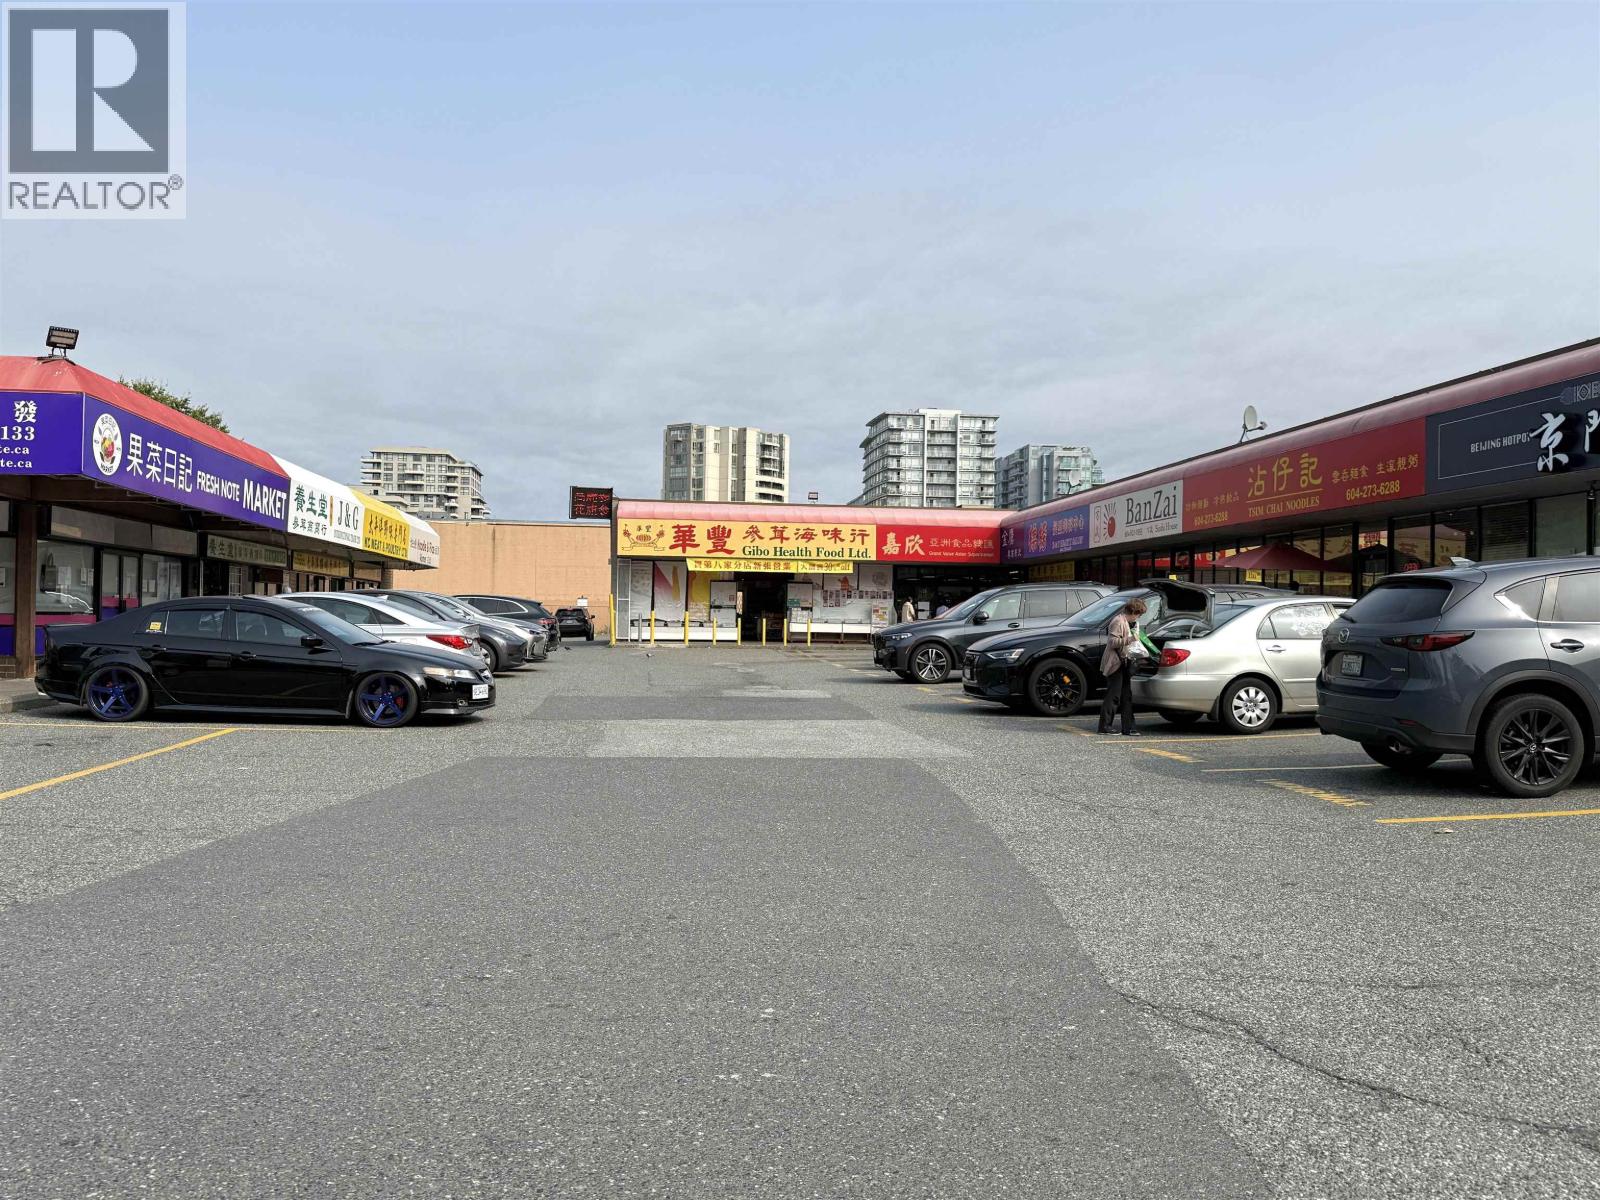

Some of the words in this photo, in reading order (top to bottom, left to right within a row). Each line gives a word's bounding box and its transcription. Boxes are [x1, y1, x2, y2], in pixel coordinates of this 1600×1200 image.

[14, 400, 38, 423] 發
[1470, 438, 1501, 453] BEIJING
[126, 432, 193, 493] 果菜日記
[1248, 453, 1323, 497] 沾仔記
[196, 470, 220, 496] FRESH
[221, 478, 240, 502] NOTE
[242, 478, 287, 520] MARKET
[1346, 480, 1400, 500] 604-273-6288
[1125, 486, 1177, 525] BanZai
[1248, 506, 1264, 517] TSIM
[1266, 502, 1283, 514] CHAI
[1285, 496, 1320, 511] NOODLES
[353, 506, 359, 530] G
[669, 524, 735, 554] 華豐
[882, 532, 925, 555] 嘉欣
[742, 545, 770, 556] Gibo
[773, 546, 812, 557] Health
[816, 547, 845, 558] Food
[848, 547, 871, 559] Ltd.
